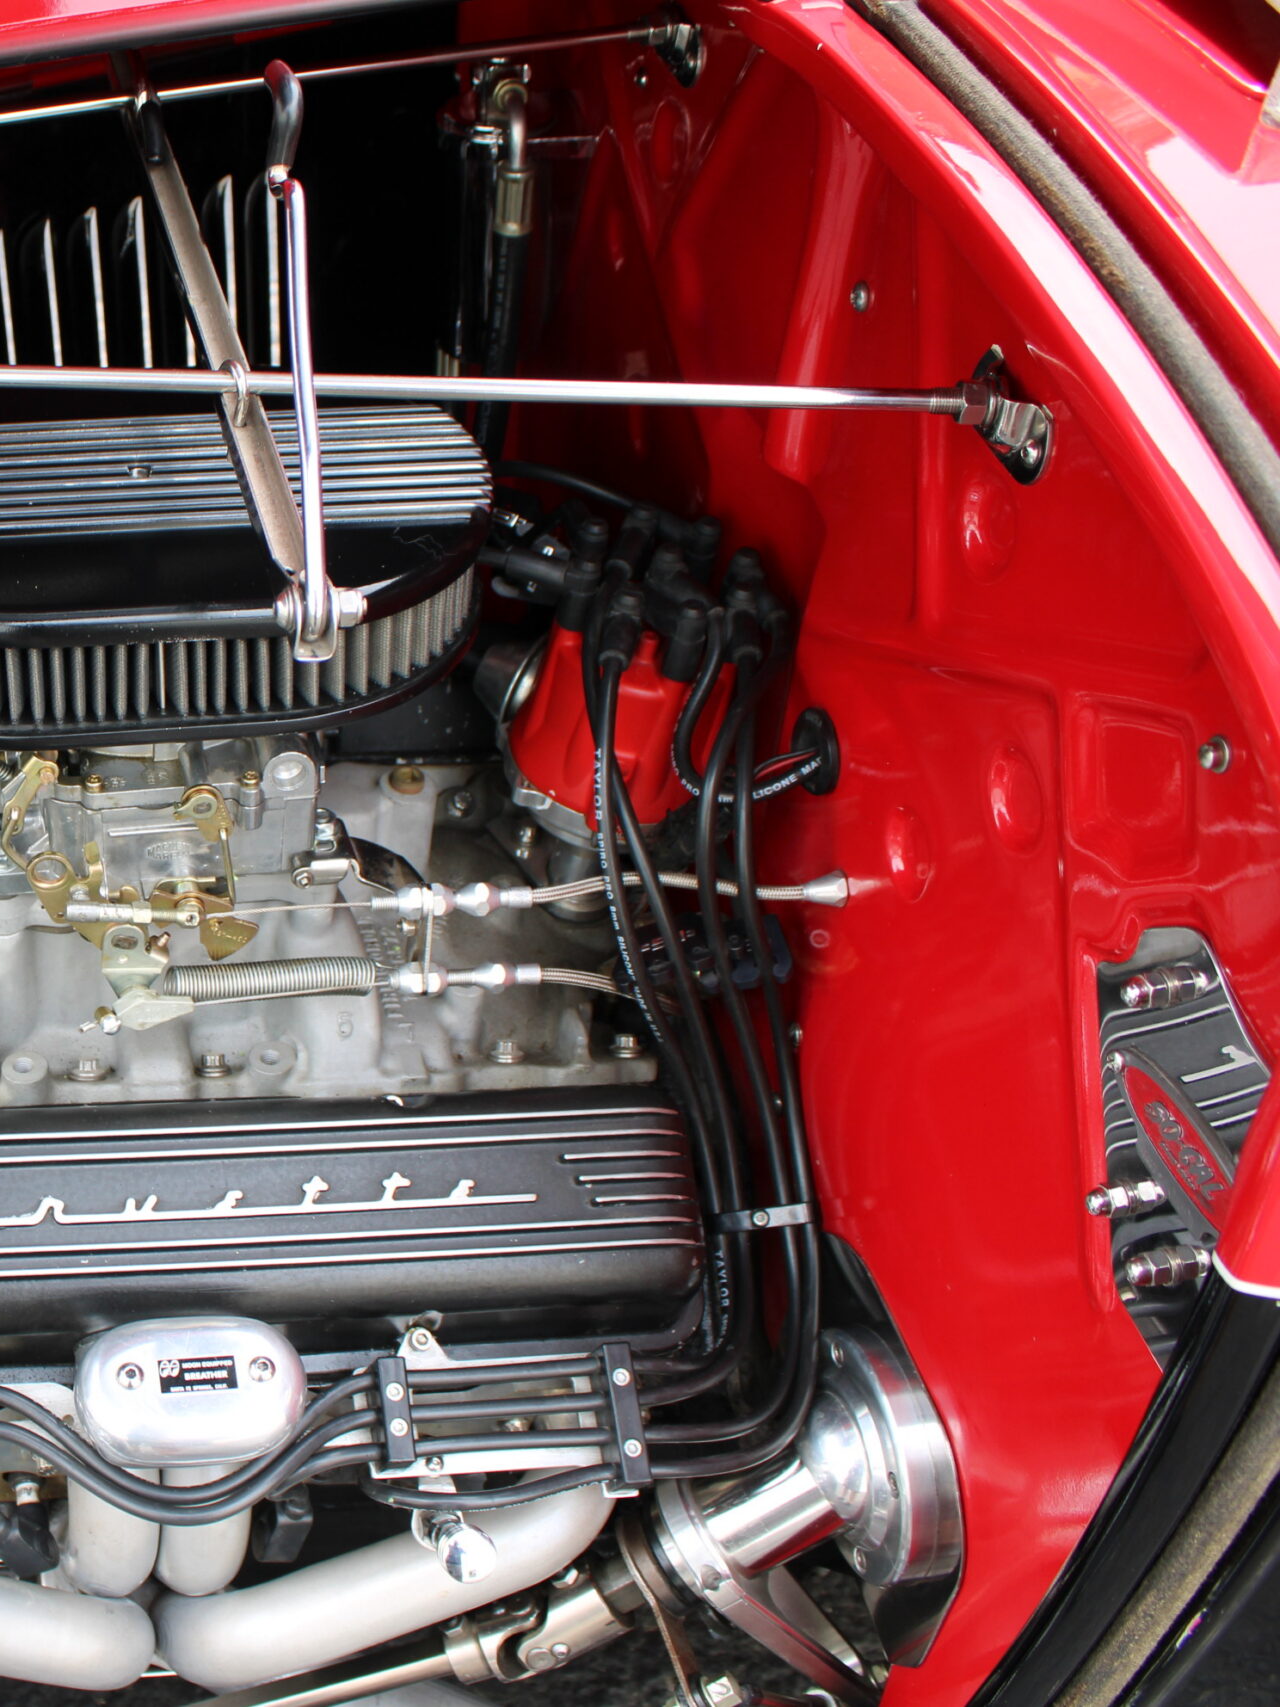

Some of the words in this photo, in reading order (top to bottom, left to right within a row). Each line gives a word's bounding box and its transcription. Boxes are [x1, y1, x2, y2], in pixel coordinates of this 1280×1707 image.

[593, 748, 603, 821] TAYLOR
[680, 778, 700, 797] PRO
[752, 774, 798, 800] LICONE
[597, 832, 608, 869] SPIRO
[604, 875, 614, 900] PRO
[714, 1250, 730, 1307] TAYLOR
[181, 1361, 201, 1369] MOON
[183, 1369, 229, 1381] BREATHER
